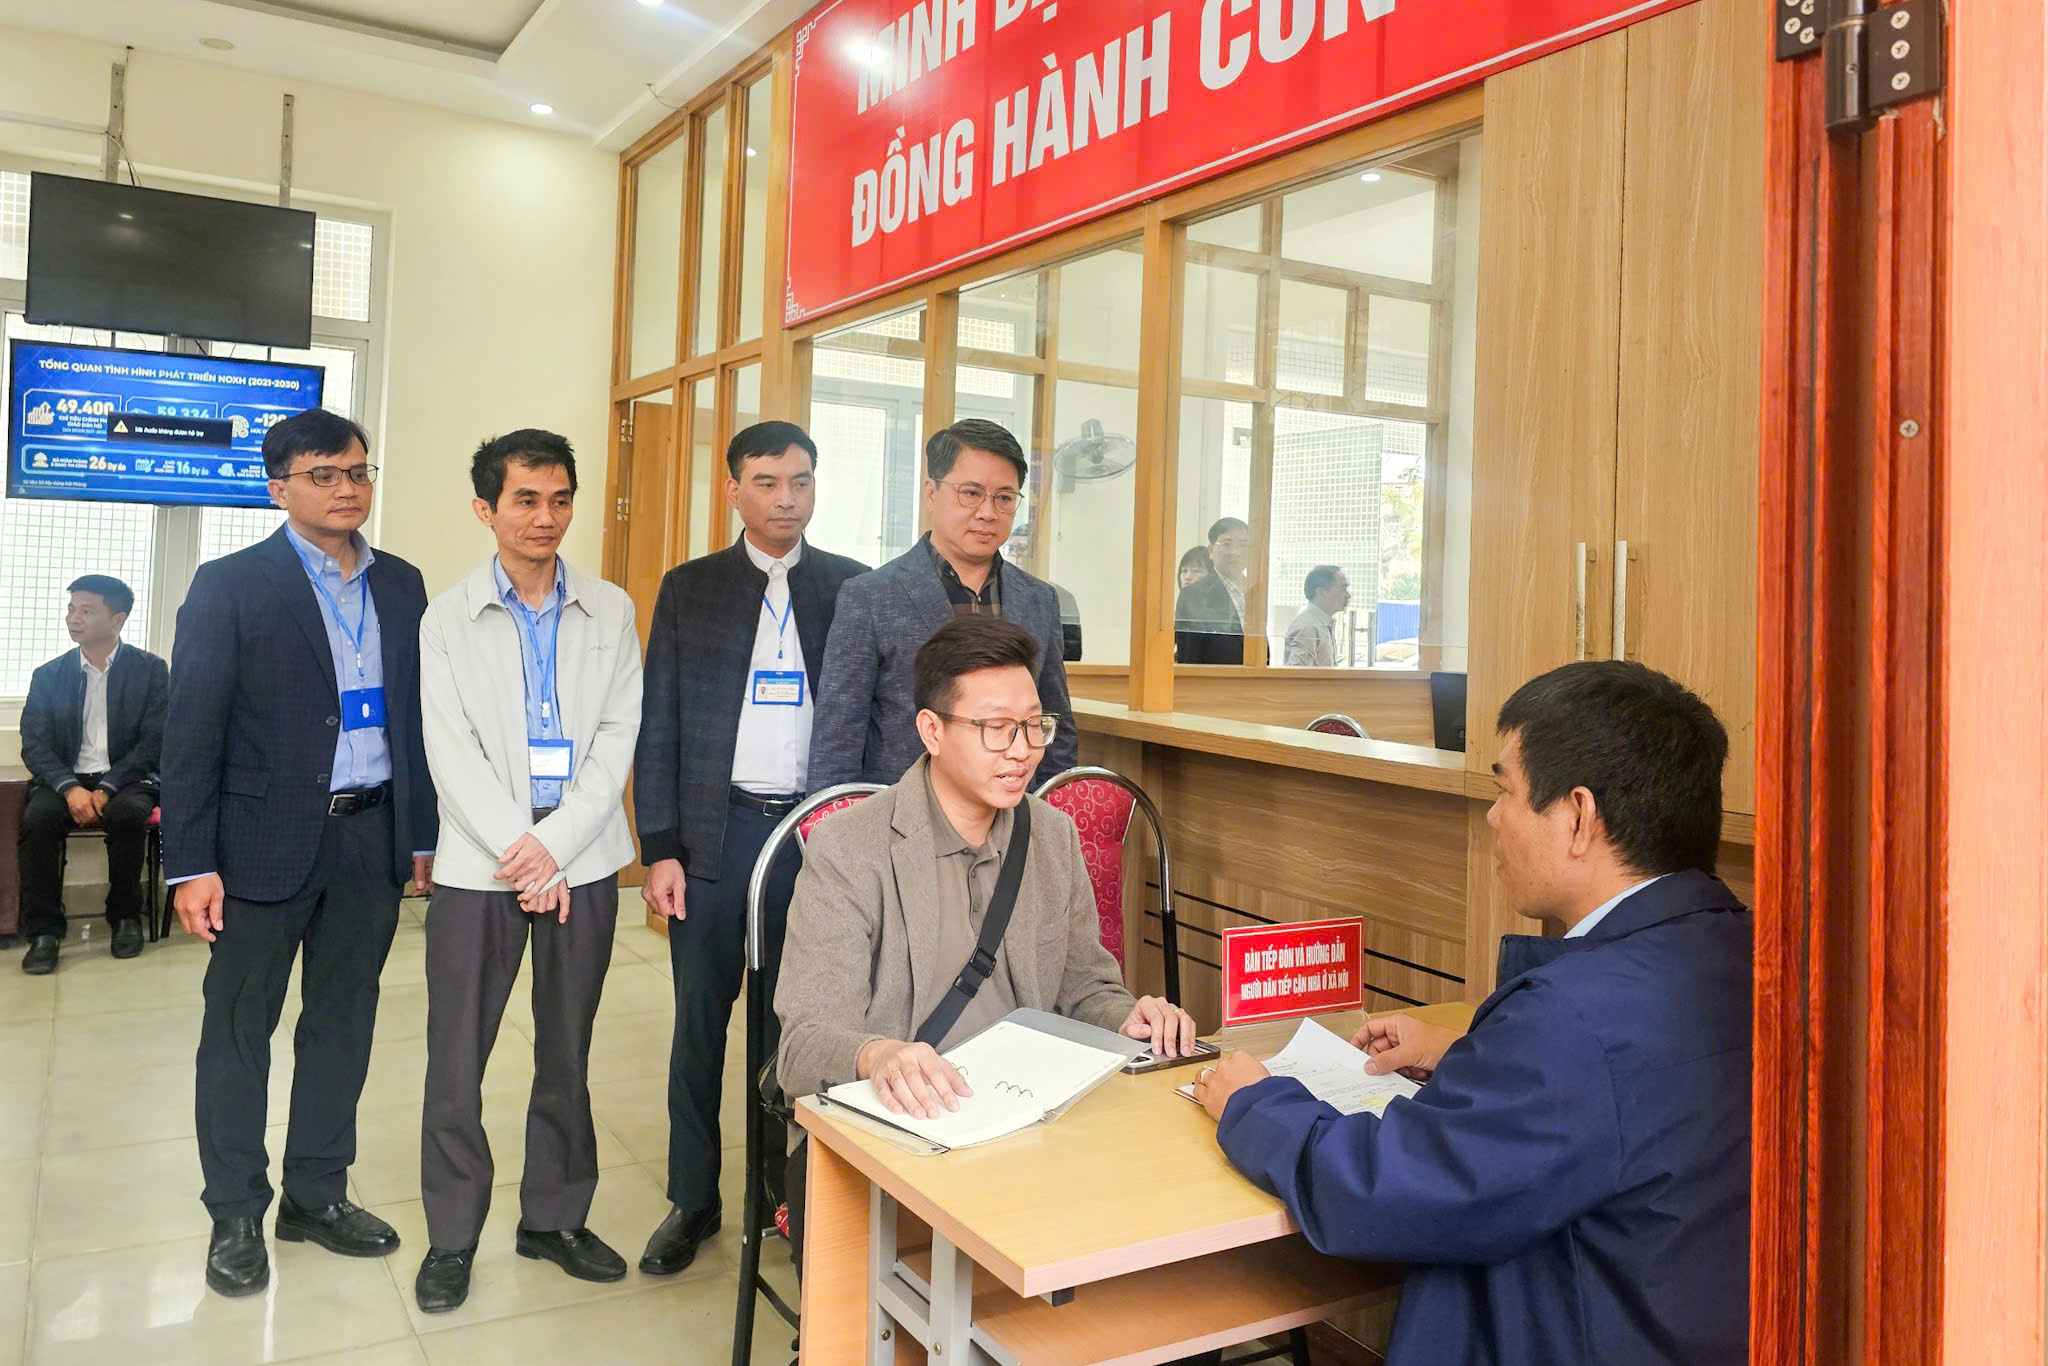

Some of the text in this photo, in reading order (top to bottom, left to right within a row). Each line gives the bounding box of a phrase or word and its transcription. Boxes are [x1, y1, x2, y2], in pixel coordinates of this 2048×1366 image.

[857, 0, 976, 115] MINH
[851, 118, 975, 248] ĐỒNG
[992, 11, 1171, 187] HÀNH
[39, 358, 300, 391] TỔNG QUAN TÌNH HÌNH PHÁT TRIỂN NOXH (2021-2030)
[89, 455, 106, 470] 26
[176, 460, 190, 474] 16
[1244, 935, 1346, 973] BÀN TIẾP ĐÓN VÀ HƯỚNG DẪN
[1241, 968, 1349, 1000] NGƯỜI DÂN TIẾP CẬN NHÀ Ở XÃ HỘI
